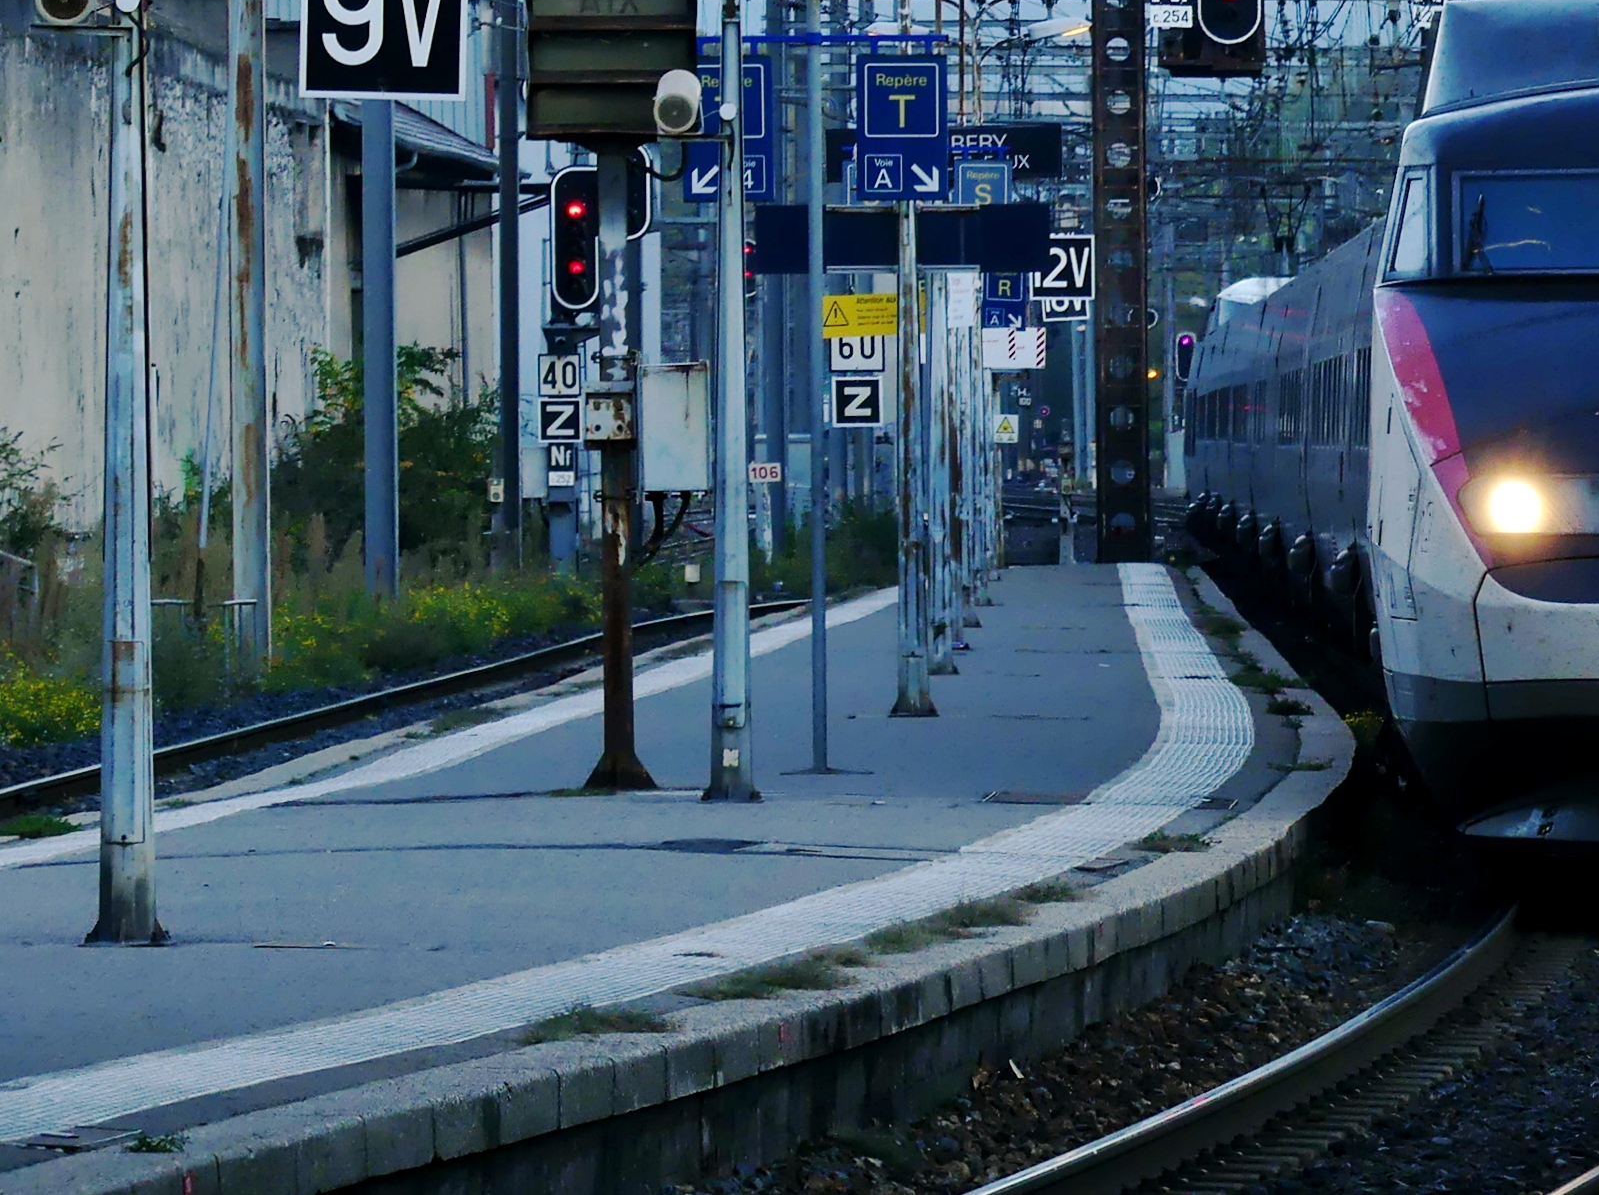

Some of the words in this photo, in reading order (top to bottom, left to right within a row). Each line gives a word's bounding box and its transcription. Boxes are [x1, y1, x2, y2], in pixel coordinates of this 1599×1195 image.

[875, 73, 927, 89] Repère
[888, 94, 916, 128] T
[874, 158, 894, 167] Voie
[873, 168, 893, 188] A
[974, 183, 992, 205] S
[998, 279, 1012, 296] R
[990, 315, 1000, 324] A
[542, 361, 577, 389] 40
[843, 386, 872, 417] Z
[545, 404, 575, 436] Z
[550, 445, 572, 466] Nf
[751, 466, 778, 479] 106
